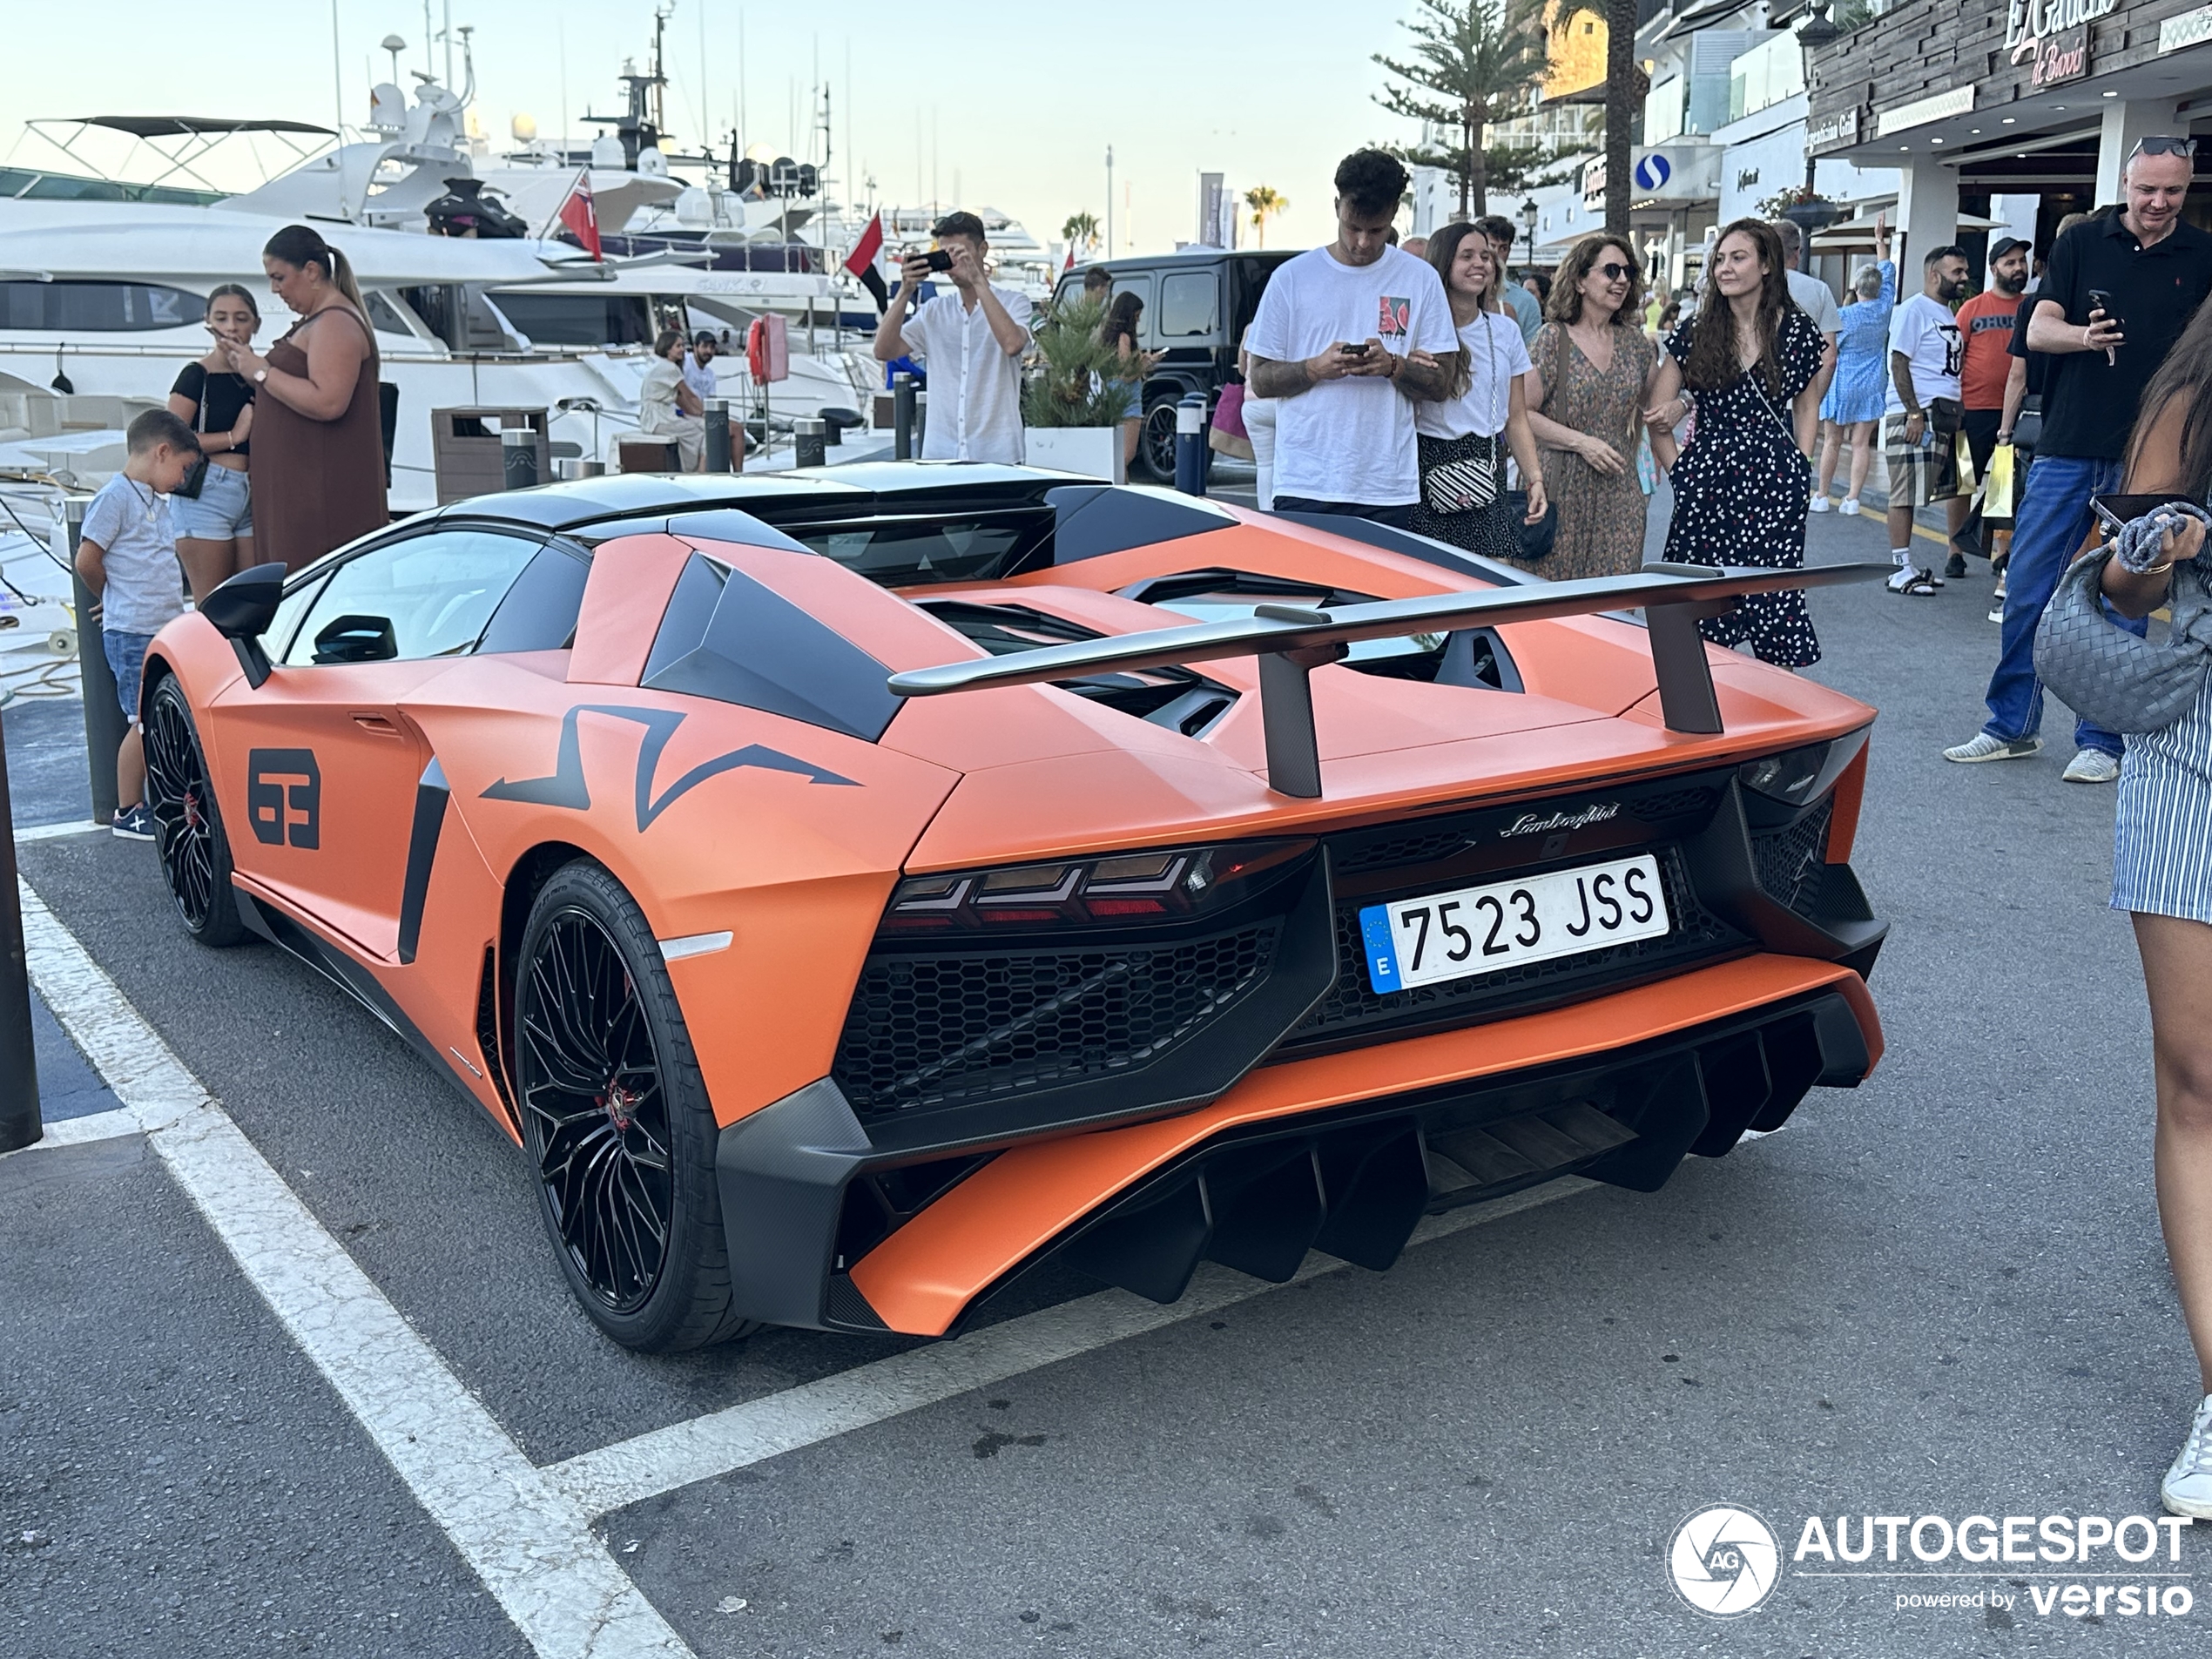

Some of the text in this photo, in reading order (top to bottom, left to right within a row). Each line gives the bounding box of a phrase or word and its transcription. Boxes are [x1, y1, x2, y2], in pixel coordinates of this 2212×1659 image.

[1838, 110, 1857, 138] Grill
[248, 748, 320, 850] 63
[1500, 801, 1621, 838] Lamborghini
[1401, 867, 1654, 972] 7523 JSS
[1377, 956, 1391, 976] E
